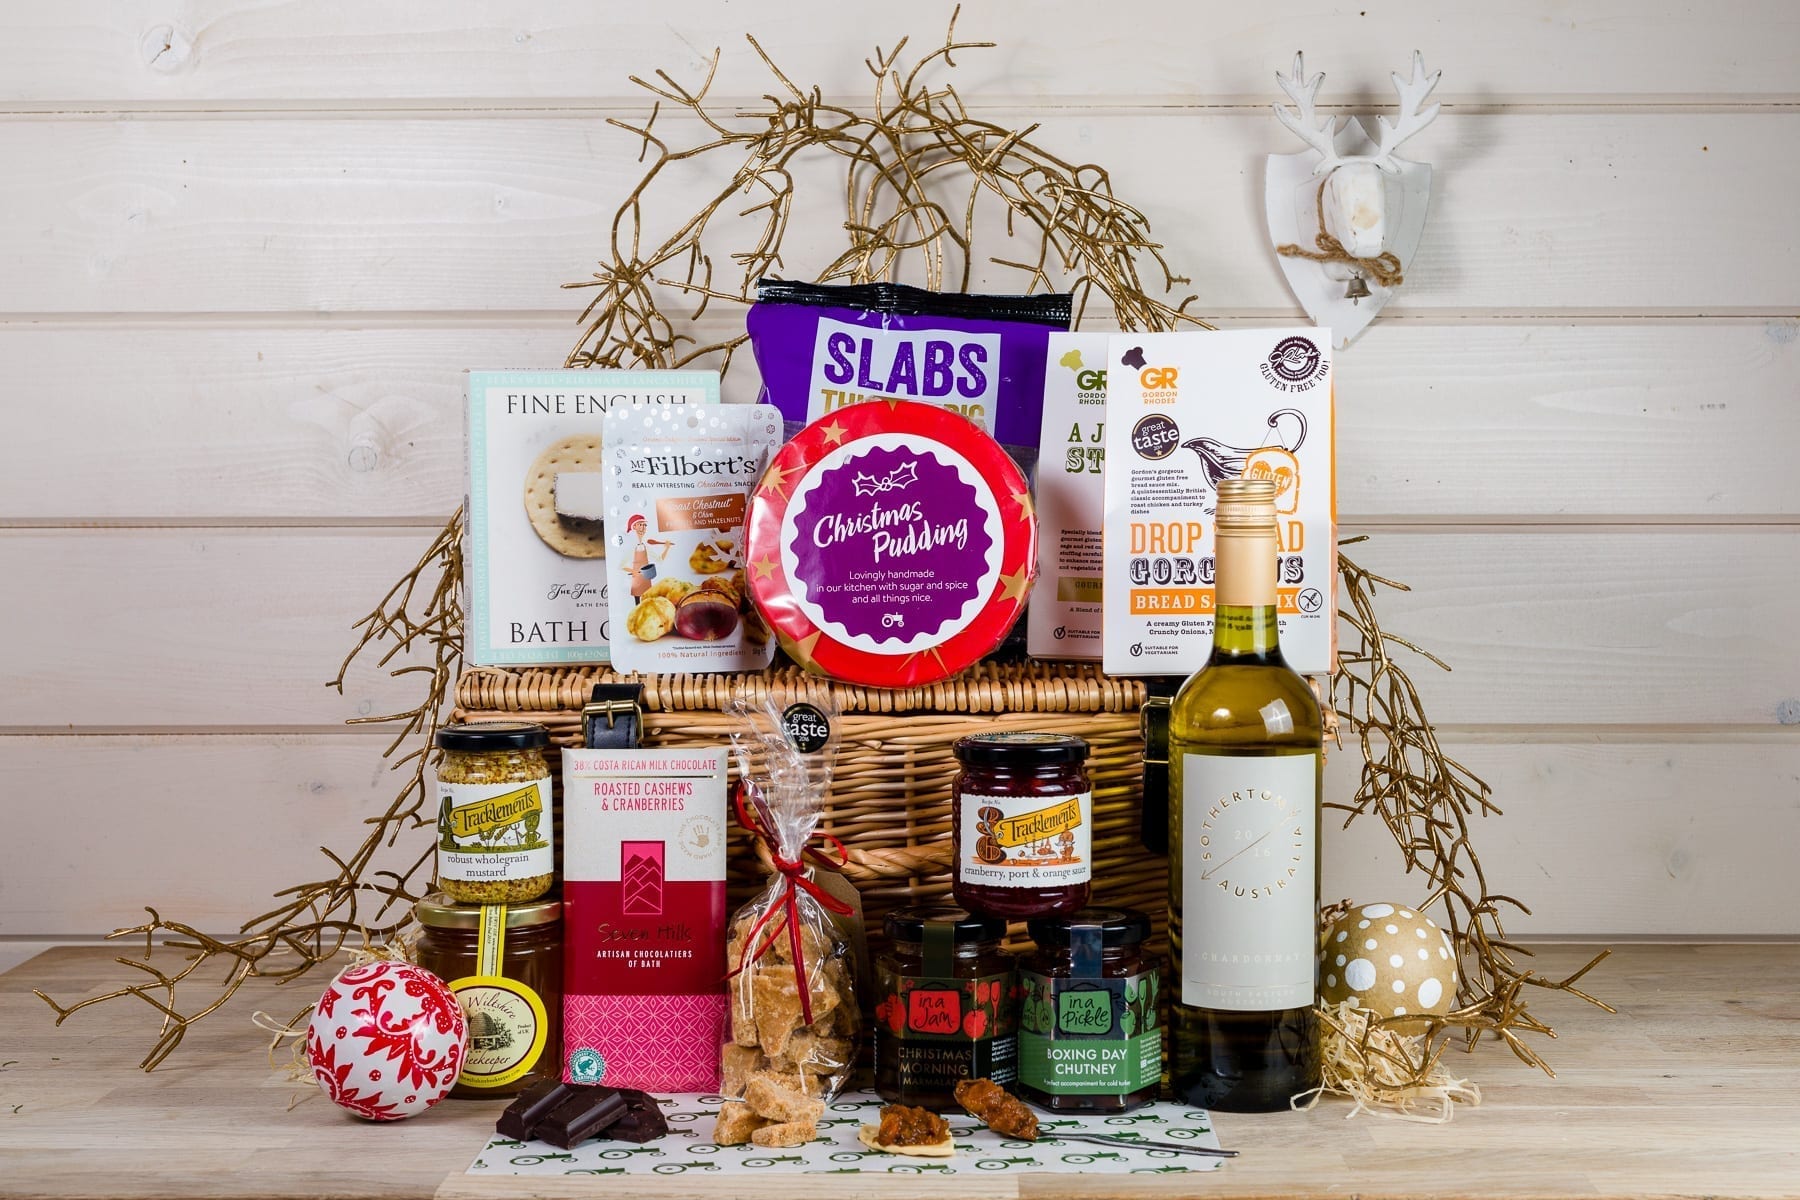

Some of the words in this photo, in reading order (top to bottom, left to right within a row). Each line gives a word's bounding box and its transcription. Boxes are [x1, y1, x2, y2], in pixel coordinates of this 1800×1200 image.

[824, 332, 988, 398] SLABS
[1140, 367, 1179, 390] GR
[1259, 363, 1288, 391] GLUTEN
[1290, 380, 1316, 393] FREE
[1313, 360, 1331, 381] TOO!
[507, 394, 566, 414] FINE
[1067, 423, 1083, 442] A
[1141, 421, 1166, 436] great
[1133, 429, 1179, 450] taste
[644, 455, 757, 476] Filbert's
[696, 480, 732, 488] Christmas
[707, 516, 741, 525] HAZELNUTS
[813, 501, 923, 548] Christmas
[872, 518, 968, 563] Pudding
[1130, 521, 1202, 554] DROP
[849, 570, 886, 581] Lovingly
[887, 569, 935, 579] handmade
[816, 583, 825, 592] in
[826, 584, 842, 592] our
[843, 582, 876, 592] kitchen
[878, 582, 898, 591] with
[899, 582, 924, 593] sugar
[926, 581, 943, 590] and
[945, 580, 969, 591] spice
[851, 594, 868, 603] and
[870, 594, 881, 602] all
[882, 593, 910, 604] things
[911, 593, 933, 602] nice.
[1135, 594, 1195, 609] BREAD
[1153, 620, 1180, 628] creamy
[509, 620, 588, 643] BATH
[1149, 629, 1180, 637] Crunchy
[657, 651, 678, 659] 100%
[679, 650, 708, 658] Natural
[792, 713, 817, 723] great
[783, 722, 828, 738] taste
[574, 760, 590, 770] 38%
[593, 760, 619, 770] COSTA
[621, 760, 647, 770] RICAN
[649, 759, 668, 770] MILK
[670, 759, 717, 770] CHOCOLATE
[594, 782, 641, 796] ROASTED
[644, 782, 693, 796] CASHEWS
[453, 790, 535, 832] Tracklements
[601, 799, 609, 811] &
[613, 797, 685, 811] CRANBERRIES
[999, 801, 1077, 842] Tracklements
[447, 854, 473, 865] robust
[474, 853, 529, 867] wholegrain
[1218, 826, 1303, 900] AUSTRALIA
[465, 866, 507, 878] mustard
[964, 865, 1006, 880] cranberry,
[1008, 869, 1029, 881] port
[1032, 868, 1040, 878] &
[1042, 868, 1071, 879] orange
[597, 923, 649, 943] Seven
[657, 924, 692, 943] Hills
[596, 950, 631, 958] ARTISAN
[634, 950, 693, 958] CHOCOLATIERS
[1201, 951, 1300, 964] CHARDONNAY
[628, 960, 637, 968] OF
[641, 960, 661, 968] BATH
[468, 992, 520, 1020] Wiltshire
[919, 994, 934, 1009] in
[935, 996, 945, 1008] a
[1069, 995, 1084, 1009] in
[1084, 997, 1094, 1008] a
[914, 1009, 953, 1029] Jam
[1062, 1007, 1110, 1028] Pickle
[898, 1047, 972, 1061] CHRISTMAS
[1047, 1048, 1097, 1060] BOXING
[1101, 1048, 1128, 1060] DAY
[900, 1062, 969, 1076] MORNING
[1055, 1063, 1117, 1075] CHUTNEY
[903, 1075, 957, 1086] MARMALAD
[1099, 1079, 1107, 1087] for
[1107, 1079, 1118, 1087] cold
